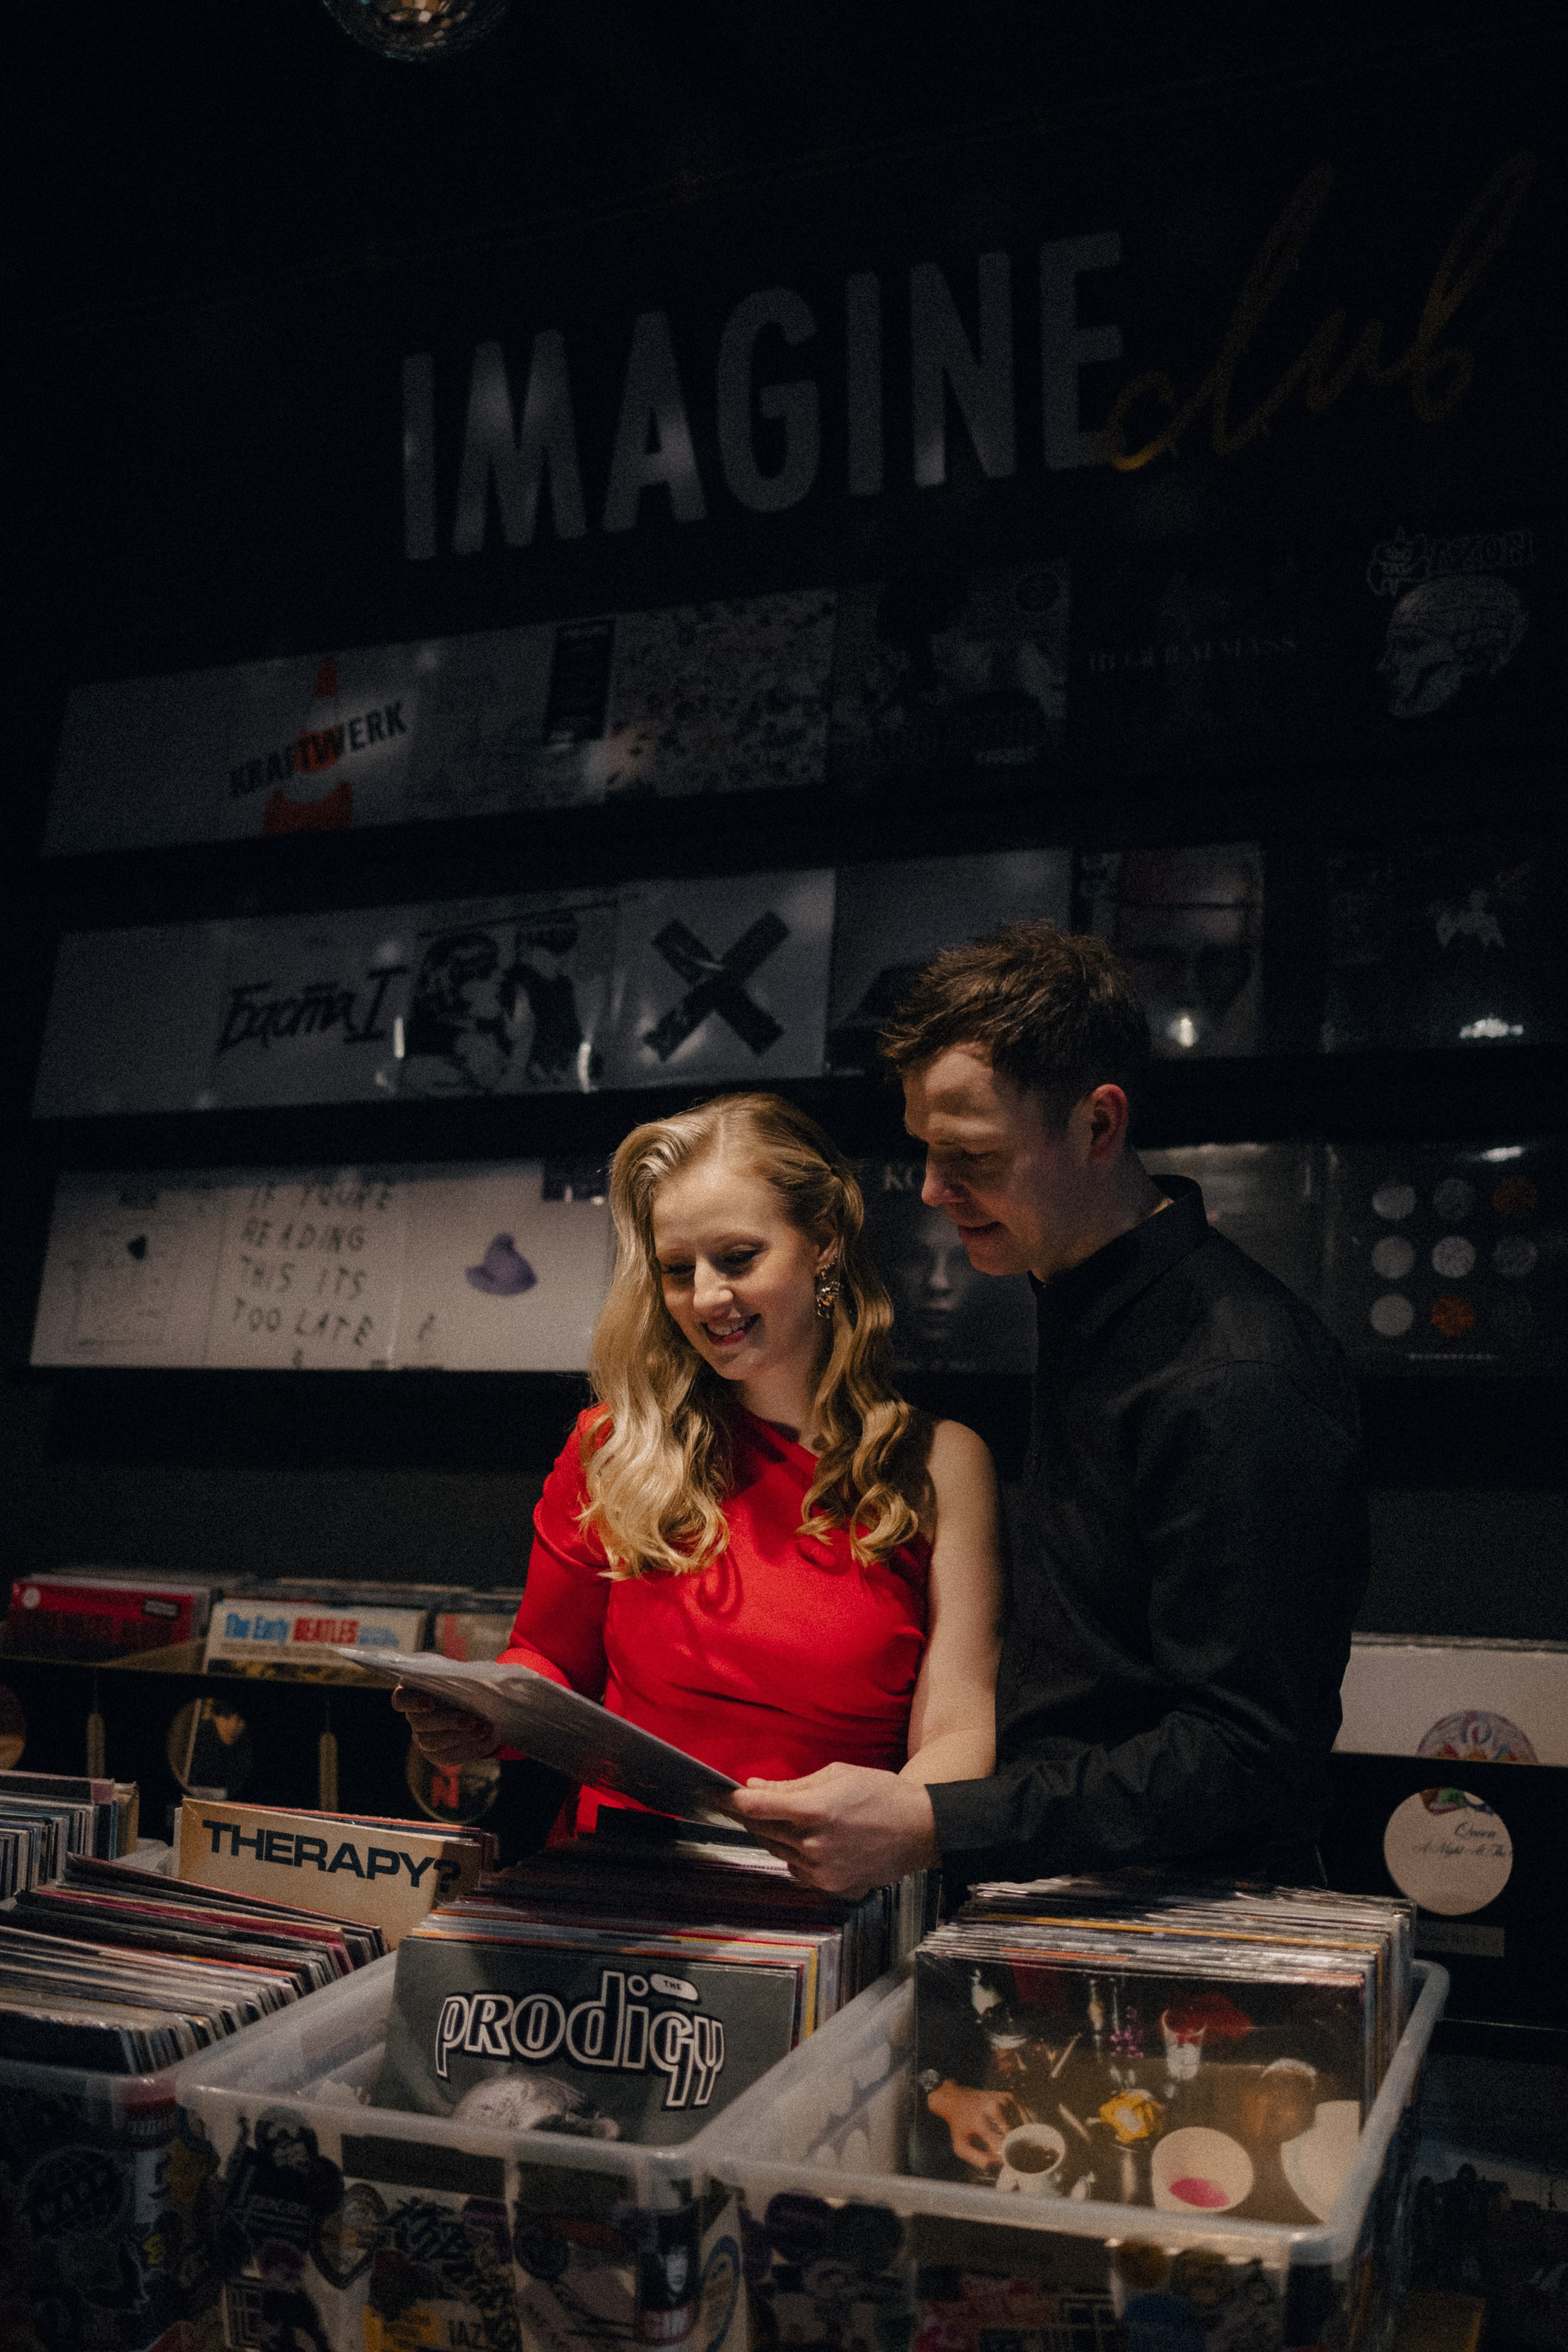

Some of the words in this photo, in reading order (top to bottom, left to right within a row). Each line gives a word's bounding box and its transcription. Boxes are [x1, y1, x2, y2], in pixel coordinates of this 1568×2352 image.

[402, 231, 1124, 561] IMAGINE
[230, 699, 407, 797] KRAFTWERK
[241, 1216, 366, 1253] READING
[241, 1254, 295, 1294] THIS
[232, 1296, 281, 1333] TOO
[295, 1308, 374, 1348] LATE
[293, 1617, 359, 1644] BEATLES
[202, 1819, 462, 1893] THERAPY?
[663, 1978, 683, 1991] THE
